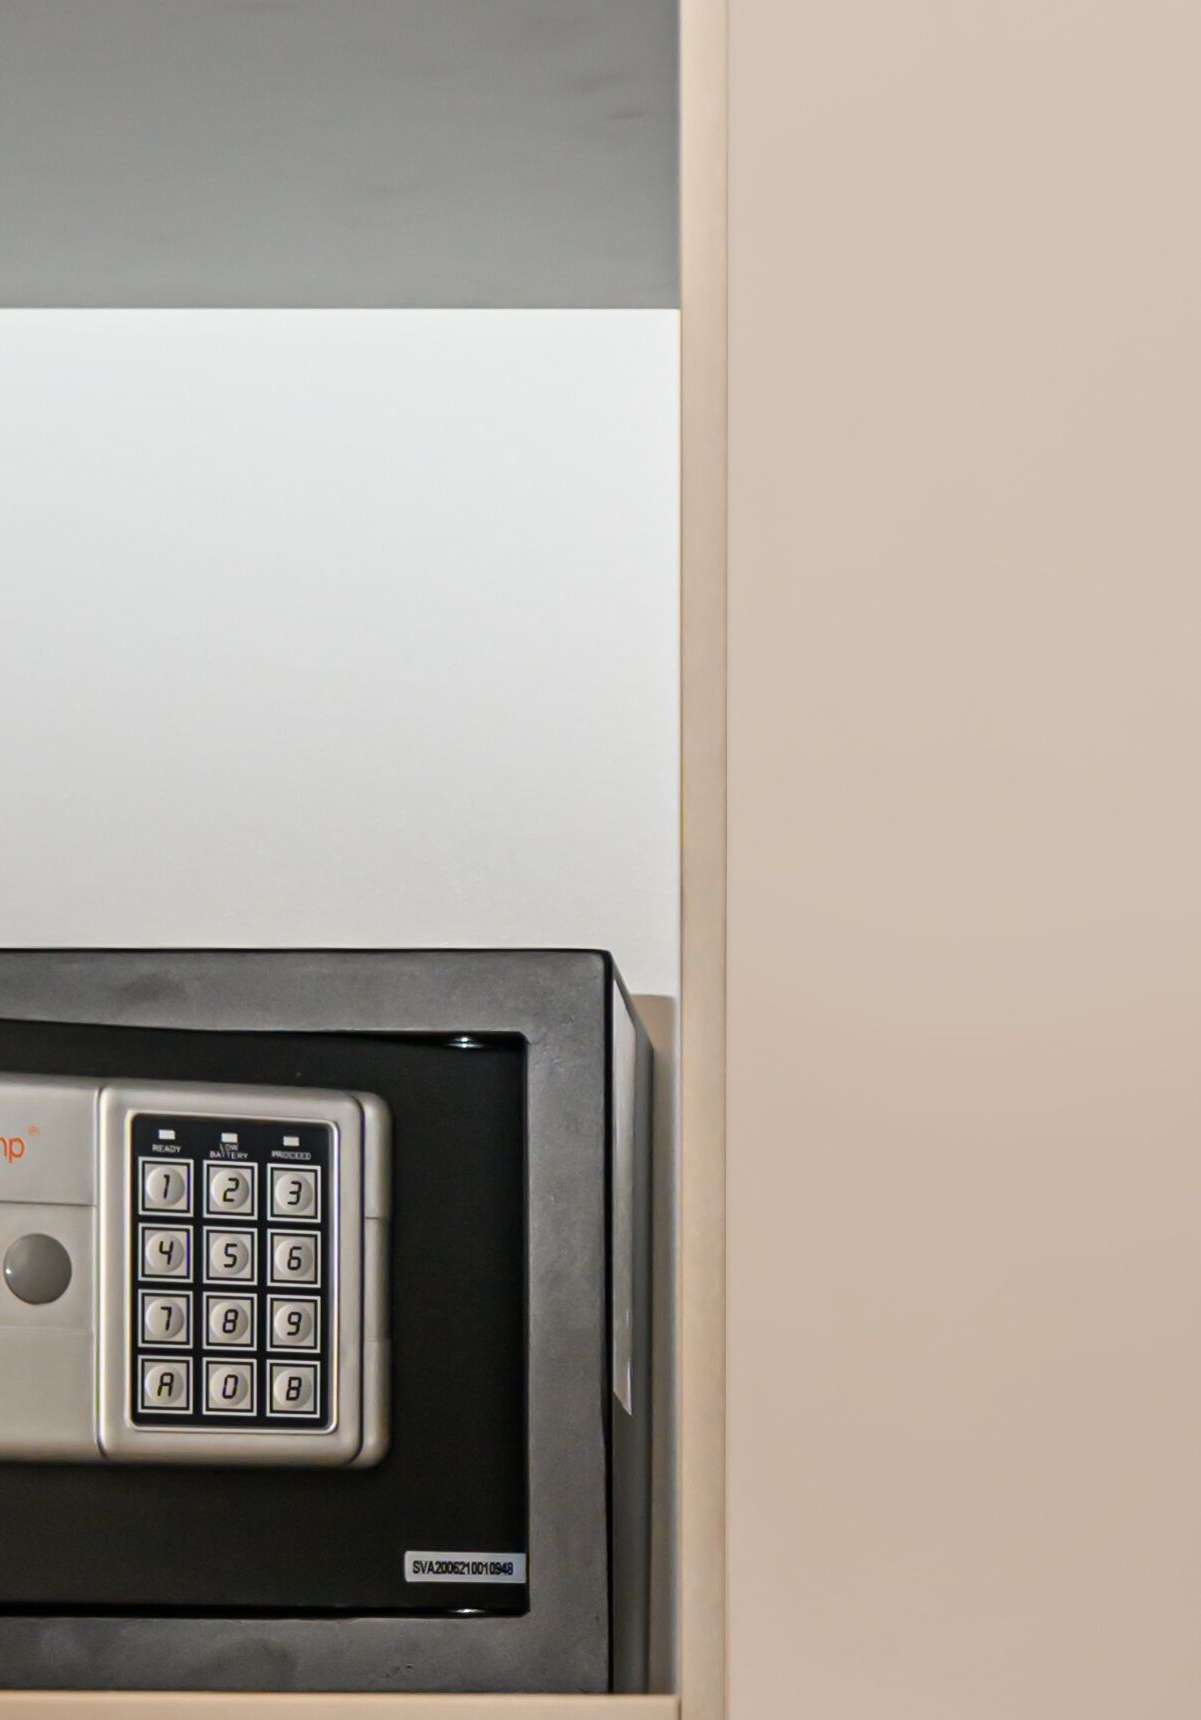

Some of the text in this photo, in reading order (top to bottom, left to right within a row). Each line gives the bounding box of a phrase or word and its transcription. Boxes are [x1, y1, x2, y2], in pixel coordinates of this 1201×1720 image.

[152, 1144, 181, 1153] READY
[210, 1151, 247, 1160] BATTERY
[271, 1151, 311, 1160] PROCEED
[163, 1174, 170, 1199] 1
[223, 1177, 239, 1202] 2
[287, 1180, 302, 1205] 3
[159, 1241, 174, 1265] 4
[224, 1243, 237, 1268] 5
[287, 1246, 302, 1270] 6
[160, 1306, 172, 1331] 7
[222, 1309, 238, 1334] 8
[287, 1312, 302, 1336] 9
[157, 1372, 174, 1397] A
[222, 1374, 238, 1399] 0
